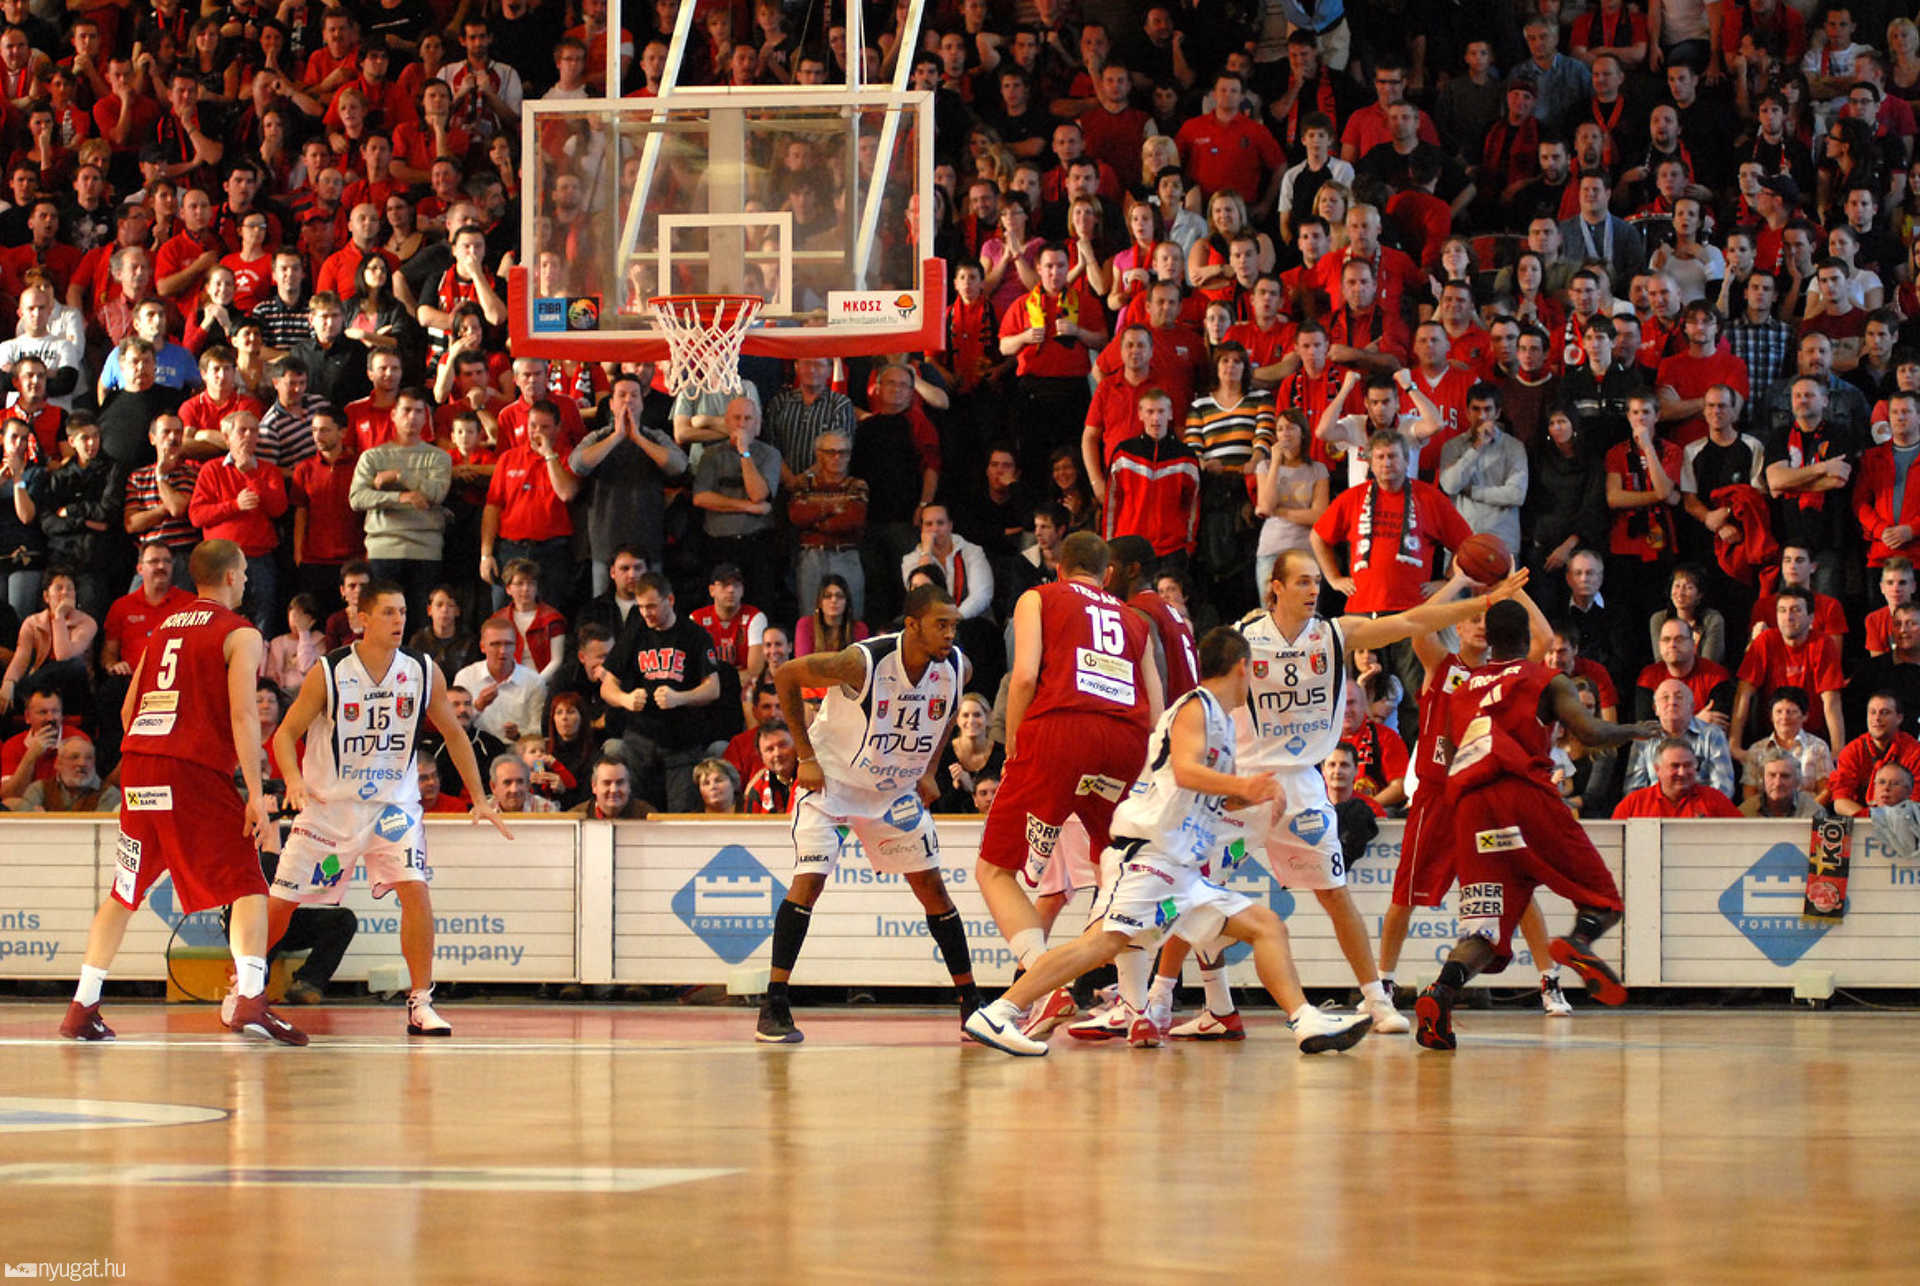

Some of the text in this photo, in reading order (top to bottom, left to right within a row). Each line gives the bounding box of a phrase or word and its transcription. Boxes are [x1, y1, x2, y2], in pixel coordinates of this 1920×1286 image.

[843, 301, 882, 312] MKOSZ
[1084, 604, 1125, 656] 15
[157, 638, 183, 689] 5
[638, 647, 686, 673] MTE
[1284, 663, 1298, 687] 8
[366, 706, 391, 730] 15
[893, 707, 921, 731] 14
[1262, 719, 1329, 737] Fortress
[342, 765, 403, 780] Fortress
[859, 757, 924, 778] Fortress
[921, 830, 940, 858] 14
[404, 848, 424, 870] 15
[800, 854, 829, 863] LEGEA
[1331, 852, 1343, 877] 8
[1460, 884, 1502, 901] RNER
[690, 919, 775, 929] FORTRESS
[1110, 913, 1144, 928] LEGEA
[0, 939, 59, 960] pany
[434, 945, 524, 965] mpany
